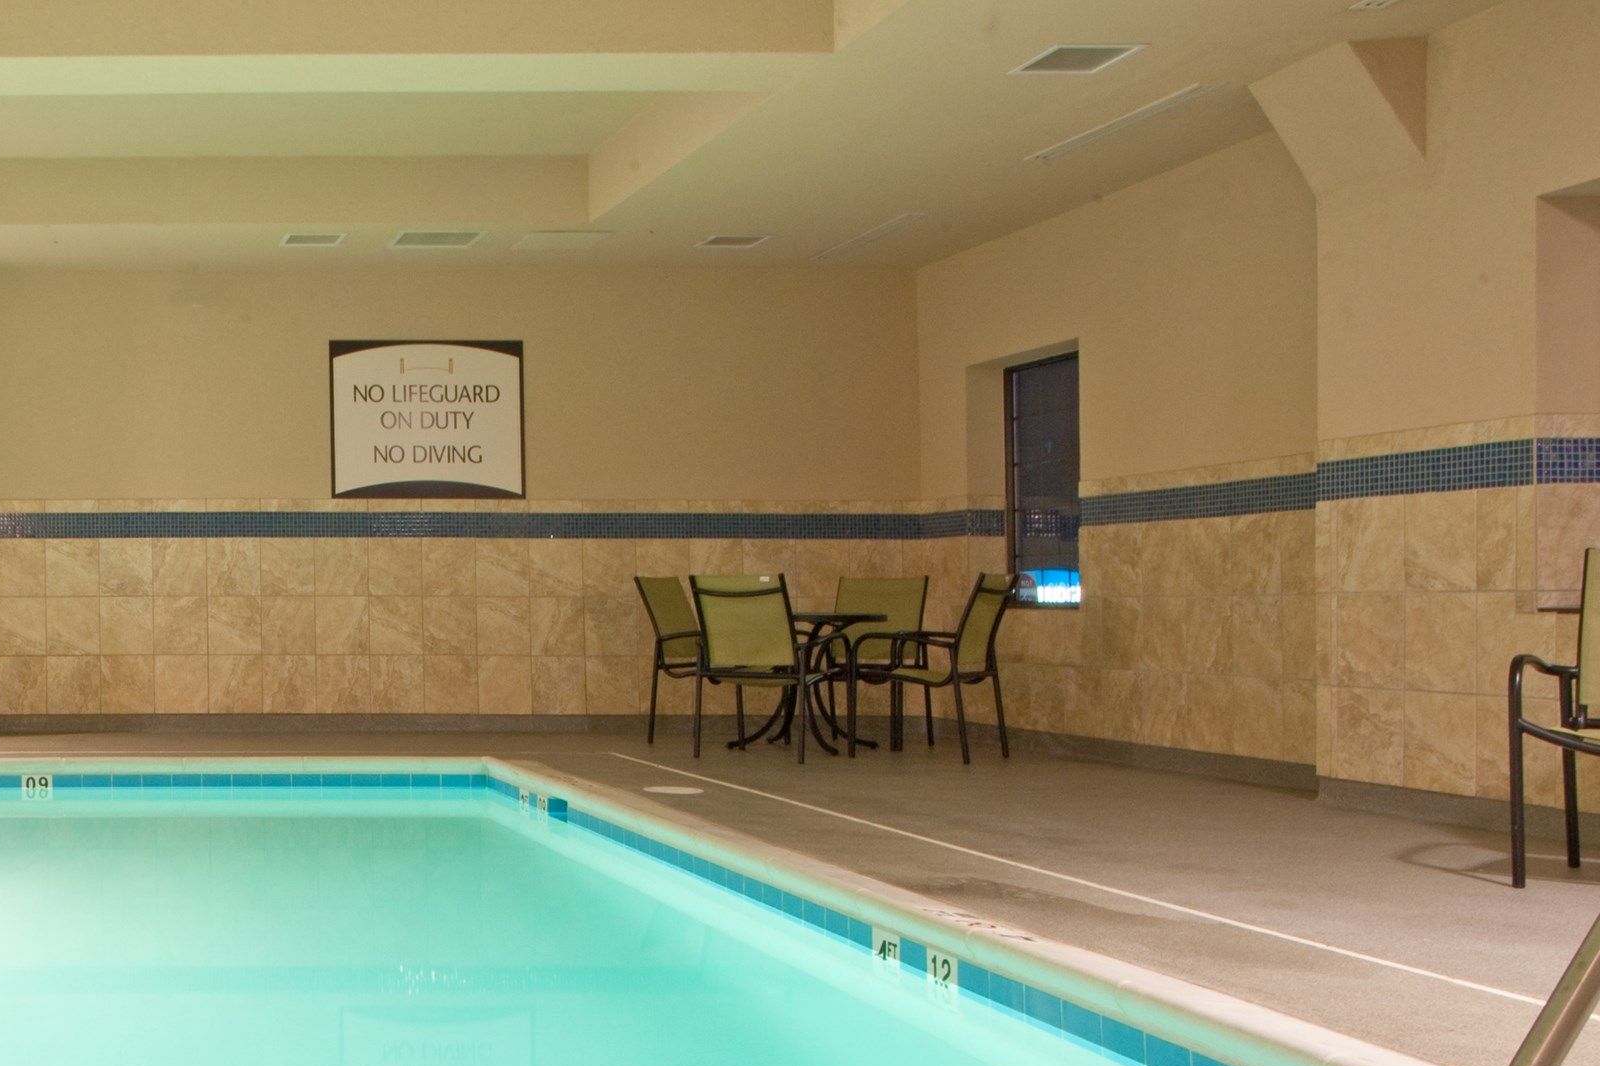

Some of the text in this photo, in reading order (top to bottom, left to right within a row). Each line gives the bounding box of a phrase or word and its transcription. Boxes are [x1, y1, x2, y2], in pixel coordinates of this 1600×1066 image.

[353, 384, 501, 403] NO LIFEGUARD
[380, 411, 475, 429] ON DUTY
[374, 445, 483, 464] NO DIVING
